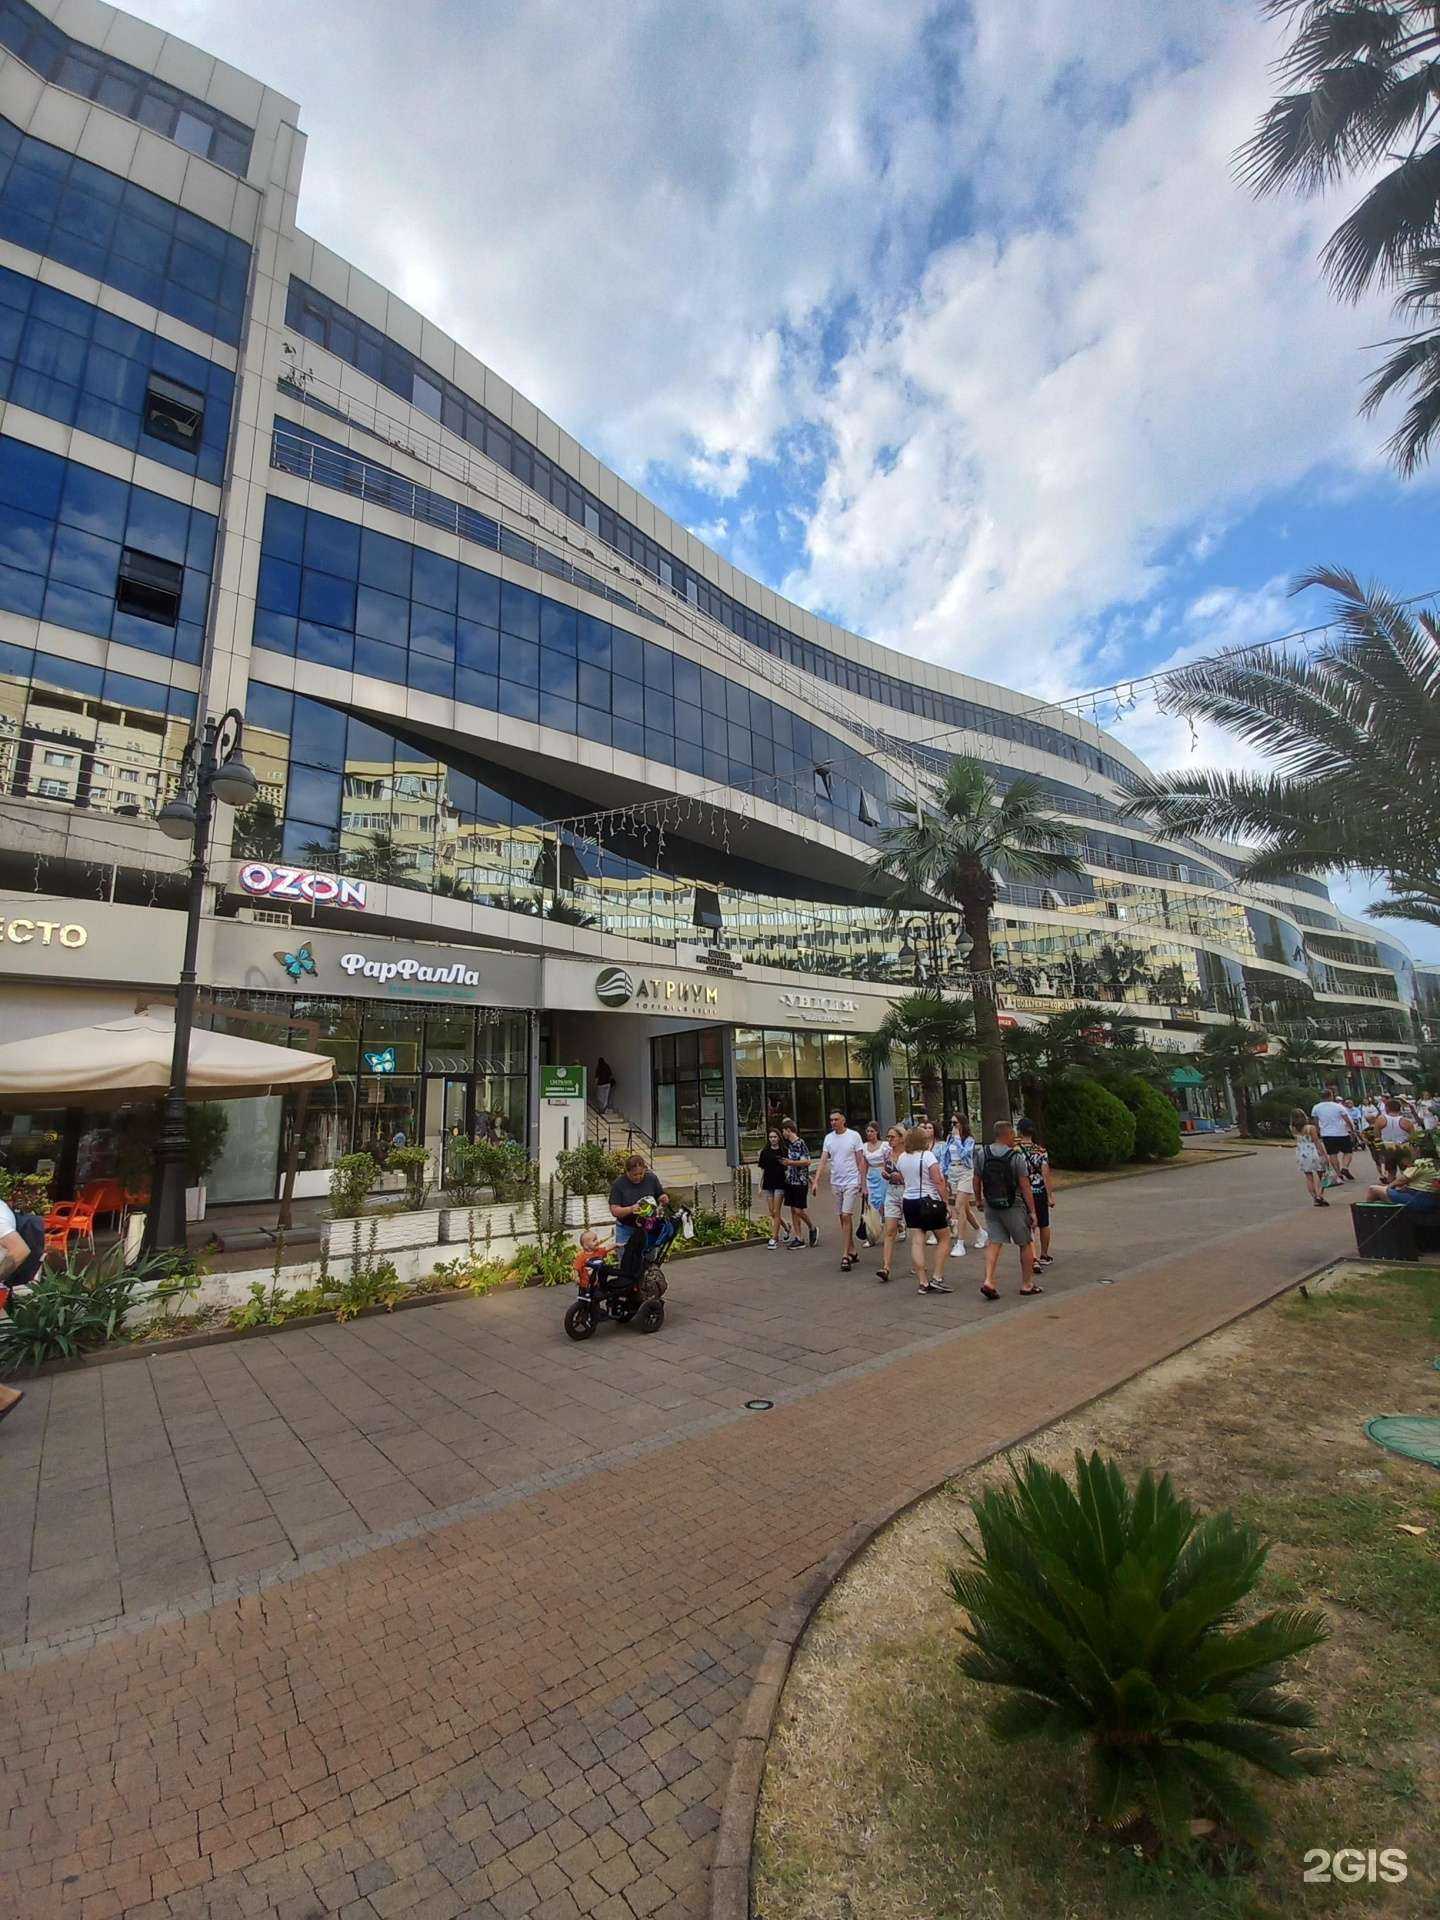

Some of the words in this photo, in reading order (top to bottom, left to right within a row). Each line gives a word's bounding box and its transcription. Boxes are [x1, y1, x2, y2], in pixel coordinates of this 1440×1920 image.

[240, 862, 367, 911] OZON
[0, 916, 88, 949] СТО
[636, 978, 718, 1005] АТРИУМ
